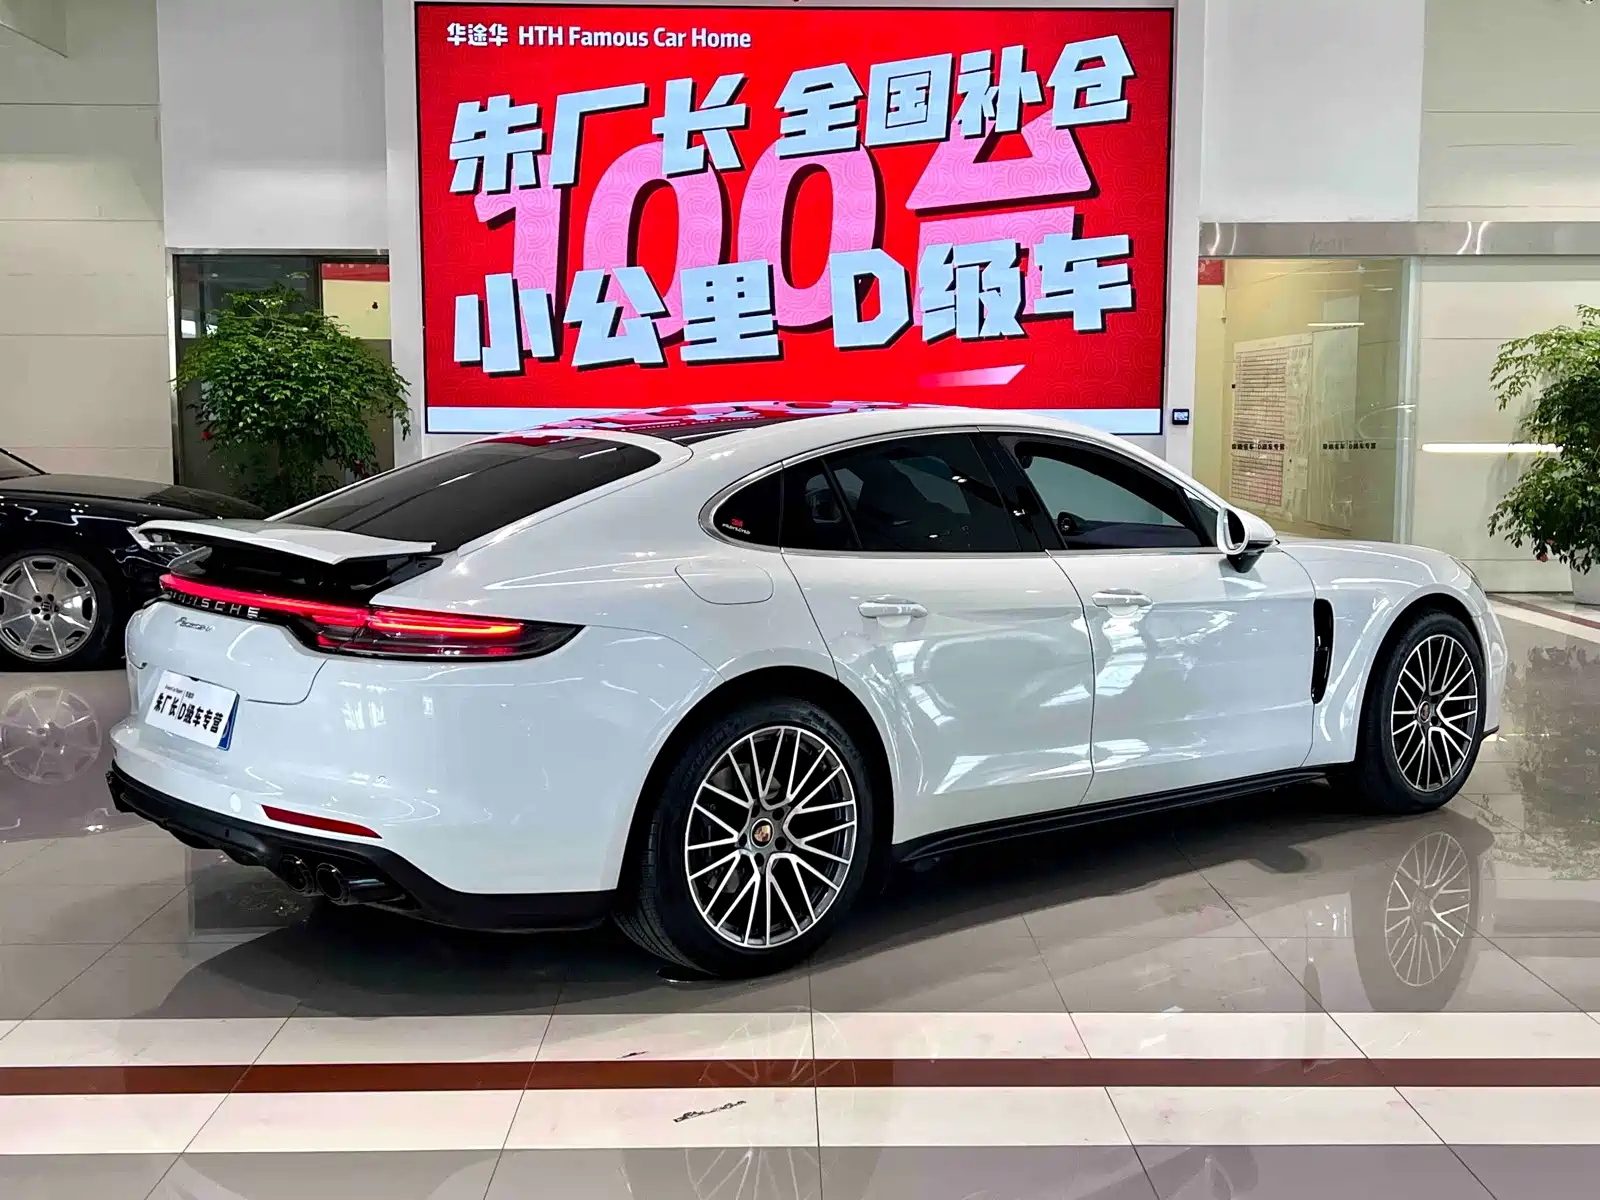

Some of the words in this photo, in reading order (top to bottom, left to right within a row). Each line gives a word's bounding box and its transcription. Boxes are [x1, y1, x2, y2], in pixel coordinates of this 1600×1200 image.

[447, 22, 508, 46] 华途华
[518, 25, 563, 46] HTH
[569, 26, 648, 47] Famous
[653, 27, 685, 47] Car
[691, 28, 751, 48] Home
[449, 73, 749, 194] 朱厂长
[775, 35, 1135, 158] 全国补仓
[453, 259, 781, 374] 小公里
[830, 234, 1134, 349] D级车
[164, 591, 260, 619] SCHE
